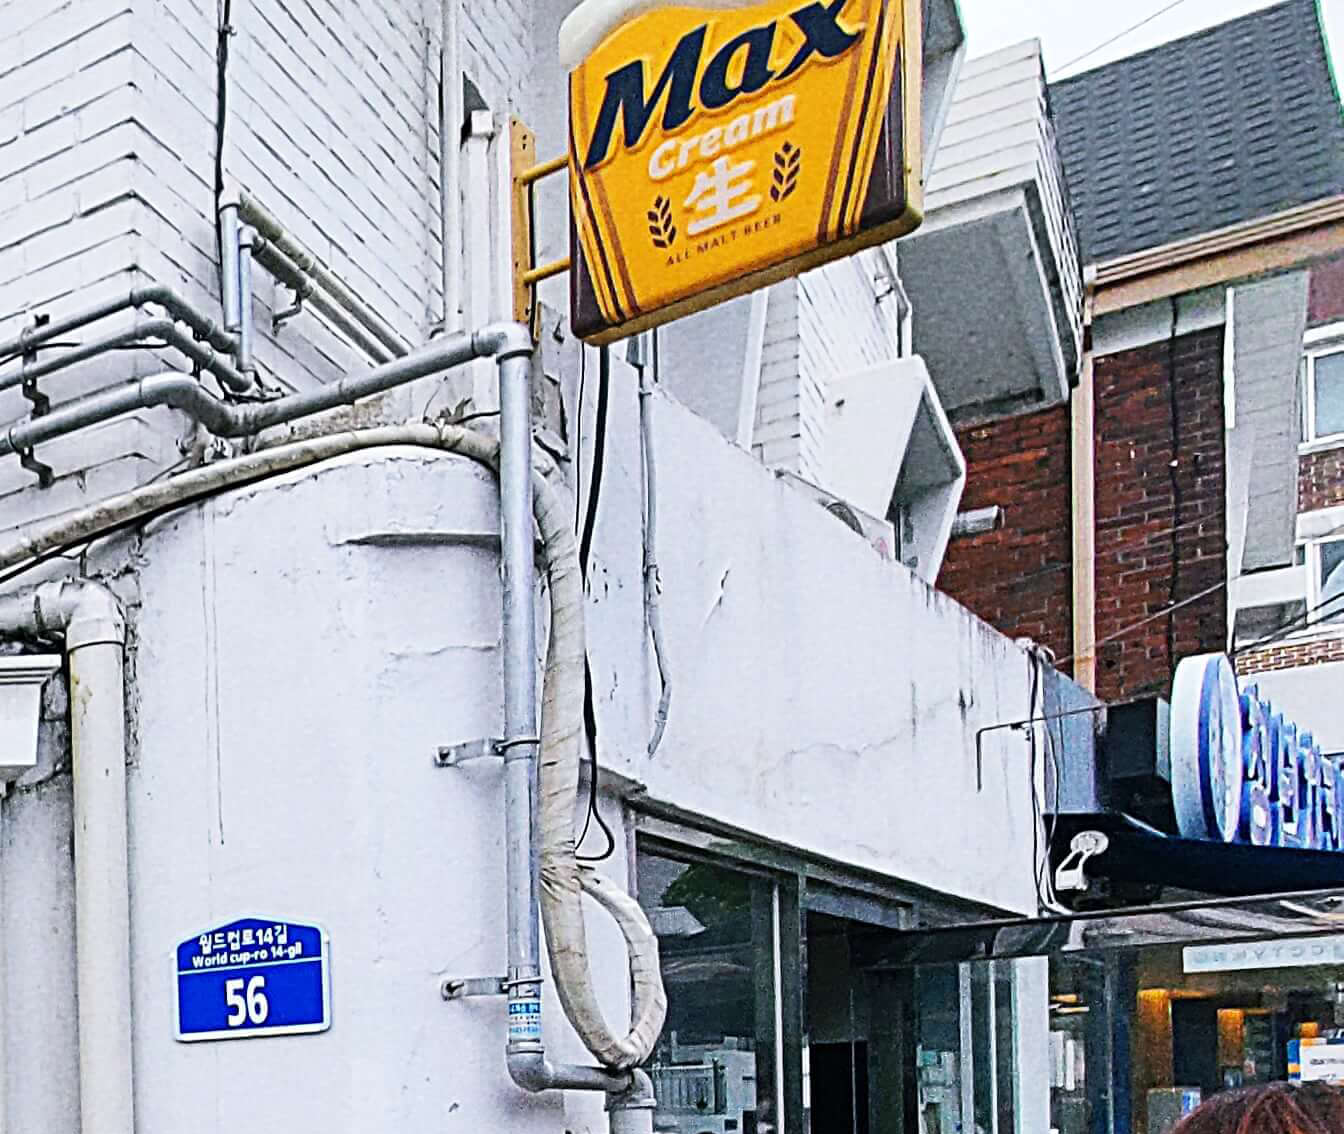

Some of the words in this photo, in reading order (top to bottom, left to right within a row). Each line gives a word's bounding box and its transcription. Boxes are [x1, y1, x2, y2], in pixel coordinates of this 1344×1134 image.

[584, 0, 863, 168] Max
[647, 94, 796, 182] Cream
[683, 155, 762, 237] 生
[666, 247, 689, 267] ALL
[696, 229, 736, 253] MALT
[743, 213, 782, 234] BEER
[192, 952, 228, 969] World
[229, 948, 268, 965] cup-ro
[226, 976, 269, 1027] 56
